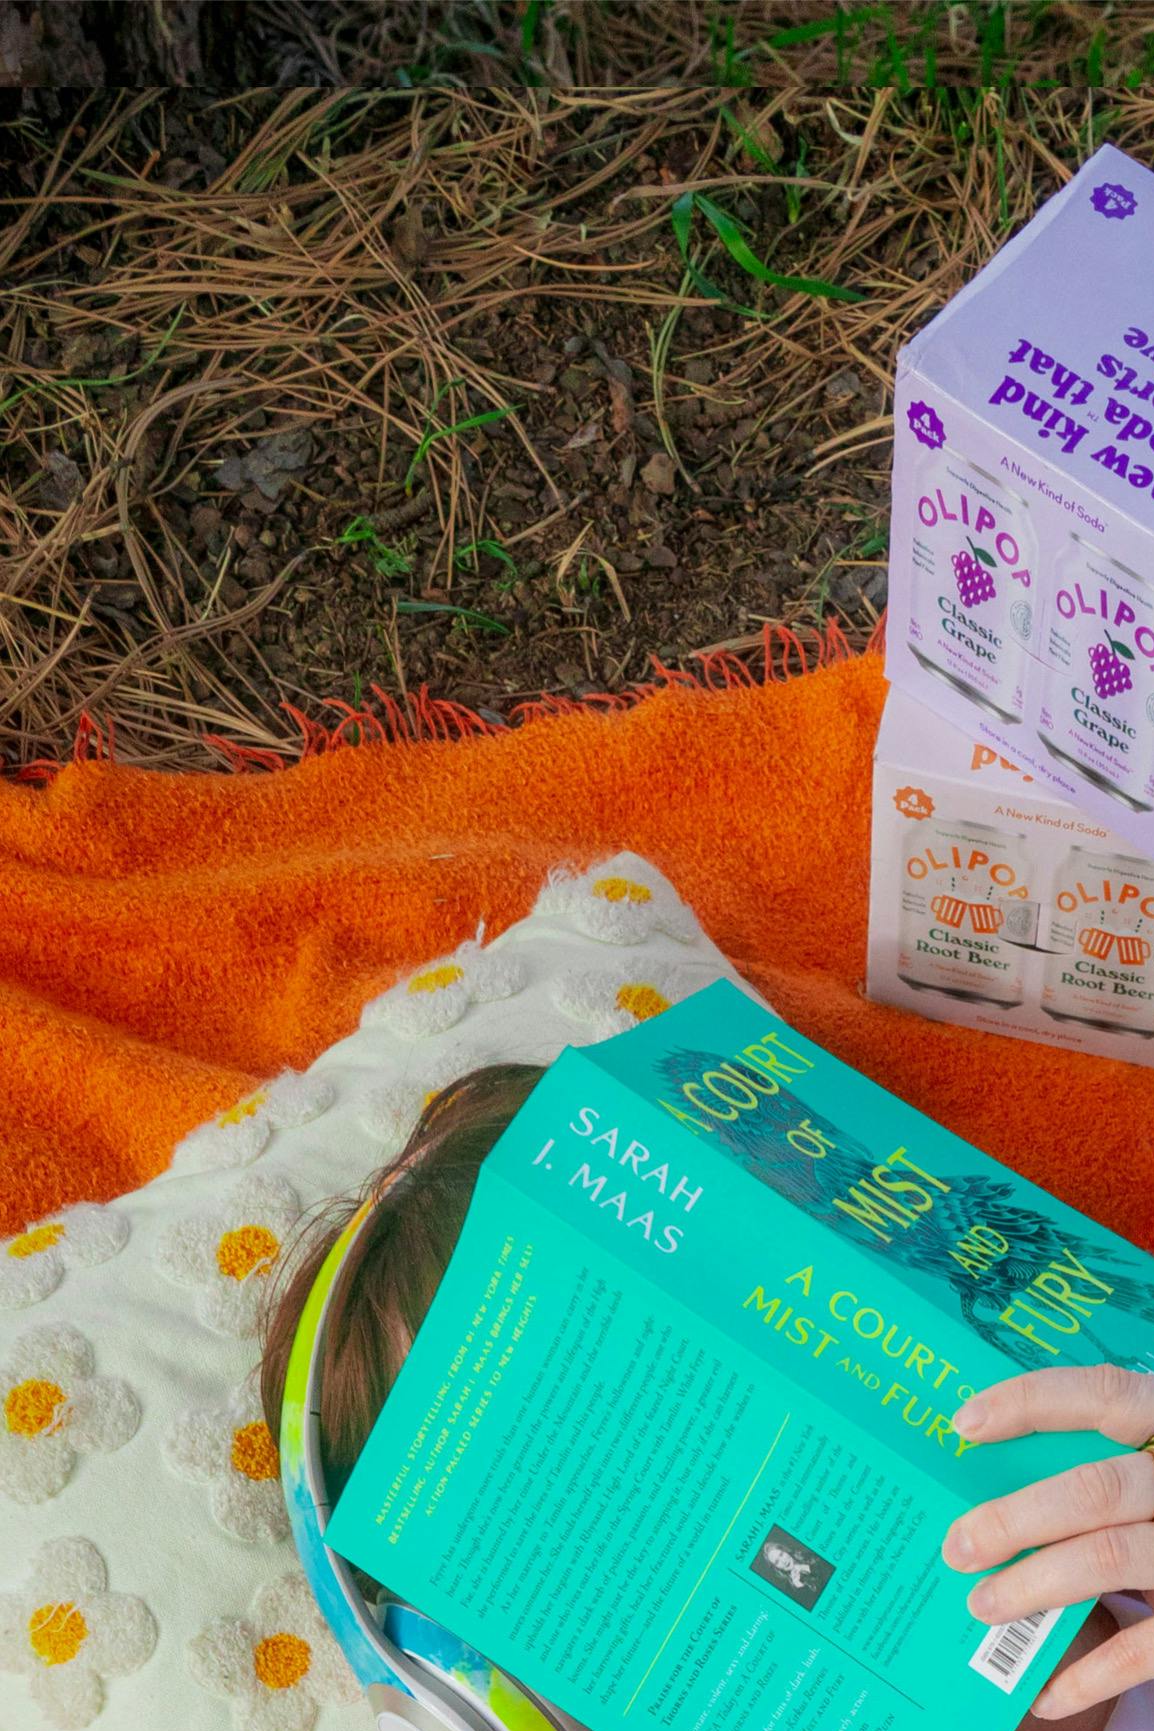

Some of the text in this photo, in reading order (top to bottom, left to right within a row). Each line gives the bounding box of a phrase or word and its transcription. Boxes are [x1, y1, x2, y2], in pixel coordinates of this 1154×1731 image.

[1008, 338, 1096, 406] that
[988, 374, 1091, 455] kind
[1000, 457, 1009, 470] A
[1011, 466, 1037, 489] New
[1037, 480, 1063, 509] Kind
[1063, 498, 1075, 512] of
[918, 488, 1030, 589] OLIPOP
[938, 596, 1002, 648] Classic
[942, 618, 997, 664] Grape
[1071, 687, 1137, 739] Classic
[1074, 709, 1130, 754] Grape
[900, 801, 928, 815] Pack
[908, 794, 918, 805] 4
[994, 806, 1003, 814] A
[1006, 808, 1033, 822] New
[1034, 814, 1061, 828] Kind
[1062, 821, 1074, 830] of
[907, 847, 1028, 900] OLIPOP
[916, 940, 1011, 971] Root Beer
[929, 928, 1000, 954] Classic
[1075, 960, 1145, 984] Classic
[1060, 972, 1105, 991] Root
[656, 1031, 815, 1135] A COURT
[569, 1107, 704, 1213] SARAH
[786, 1119, 836, 1158] OF
[568, 1162, 684, 1253] MAAS
[832, 1147, 952, 1244] MIST
[947, 1224, 1009, 1279] AND
[784, 1264, 976, 1400] A COURT O
[1000, 1248, 1115, 1356] FURY
[468, 1388, 492, 1429] SERIES
[490, 1370, 501, 1386] TO
[498, 1343, 514, 1368] NEW
[510, 1294, 537, 1342] HEIGHTS
[742, 1285, 840, 1358] MIST
[836, 1357, 881, 1390] AND
[375, 1463, 409, 1525] MASTERFUL
[406, 1379, 450, 1461] STORYTELLING
[447, 1344, 468, 1378] FROM
[471, 1303, 487, 1327] NEW
[483, 1269, 502, 1299] YORK
[496, 1234, 516, 1265] TIMES
[387, 1475, 426, 1545] BESTSELLING
[424, 1427, 449, 1472] AUTHOR
[447, 1385, 471, 1425] SARAH
[472, 1339, 492, 1373] MAAS
[489, 1295, 514, 1338] BRINGS
[508, 1271, 524, 1294] HER
[735, 1526, 758, 1562] SARAH
[759, 1487, 780, 1518] MAAS
[647, 1680, 672, 1716] PRAISE
[669, 1663, 683, 1682] FOR
[681, 1644, 694, 1661] THE
[689, 1608, 713, 1642] COURT
[661, 1603, 737, 1727] THORNS AND ROSES SERIES
